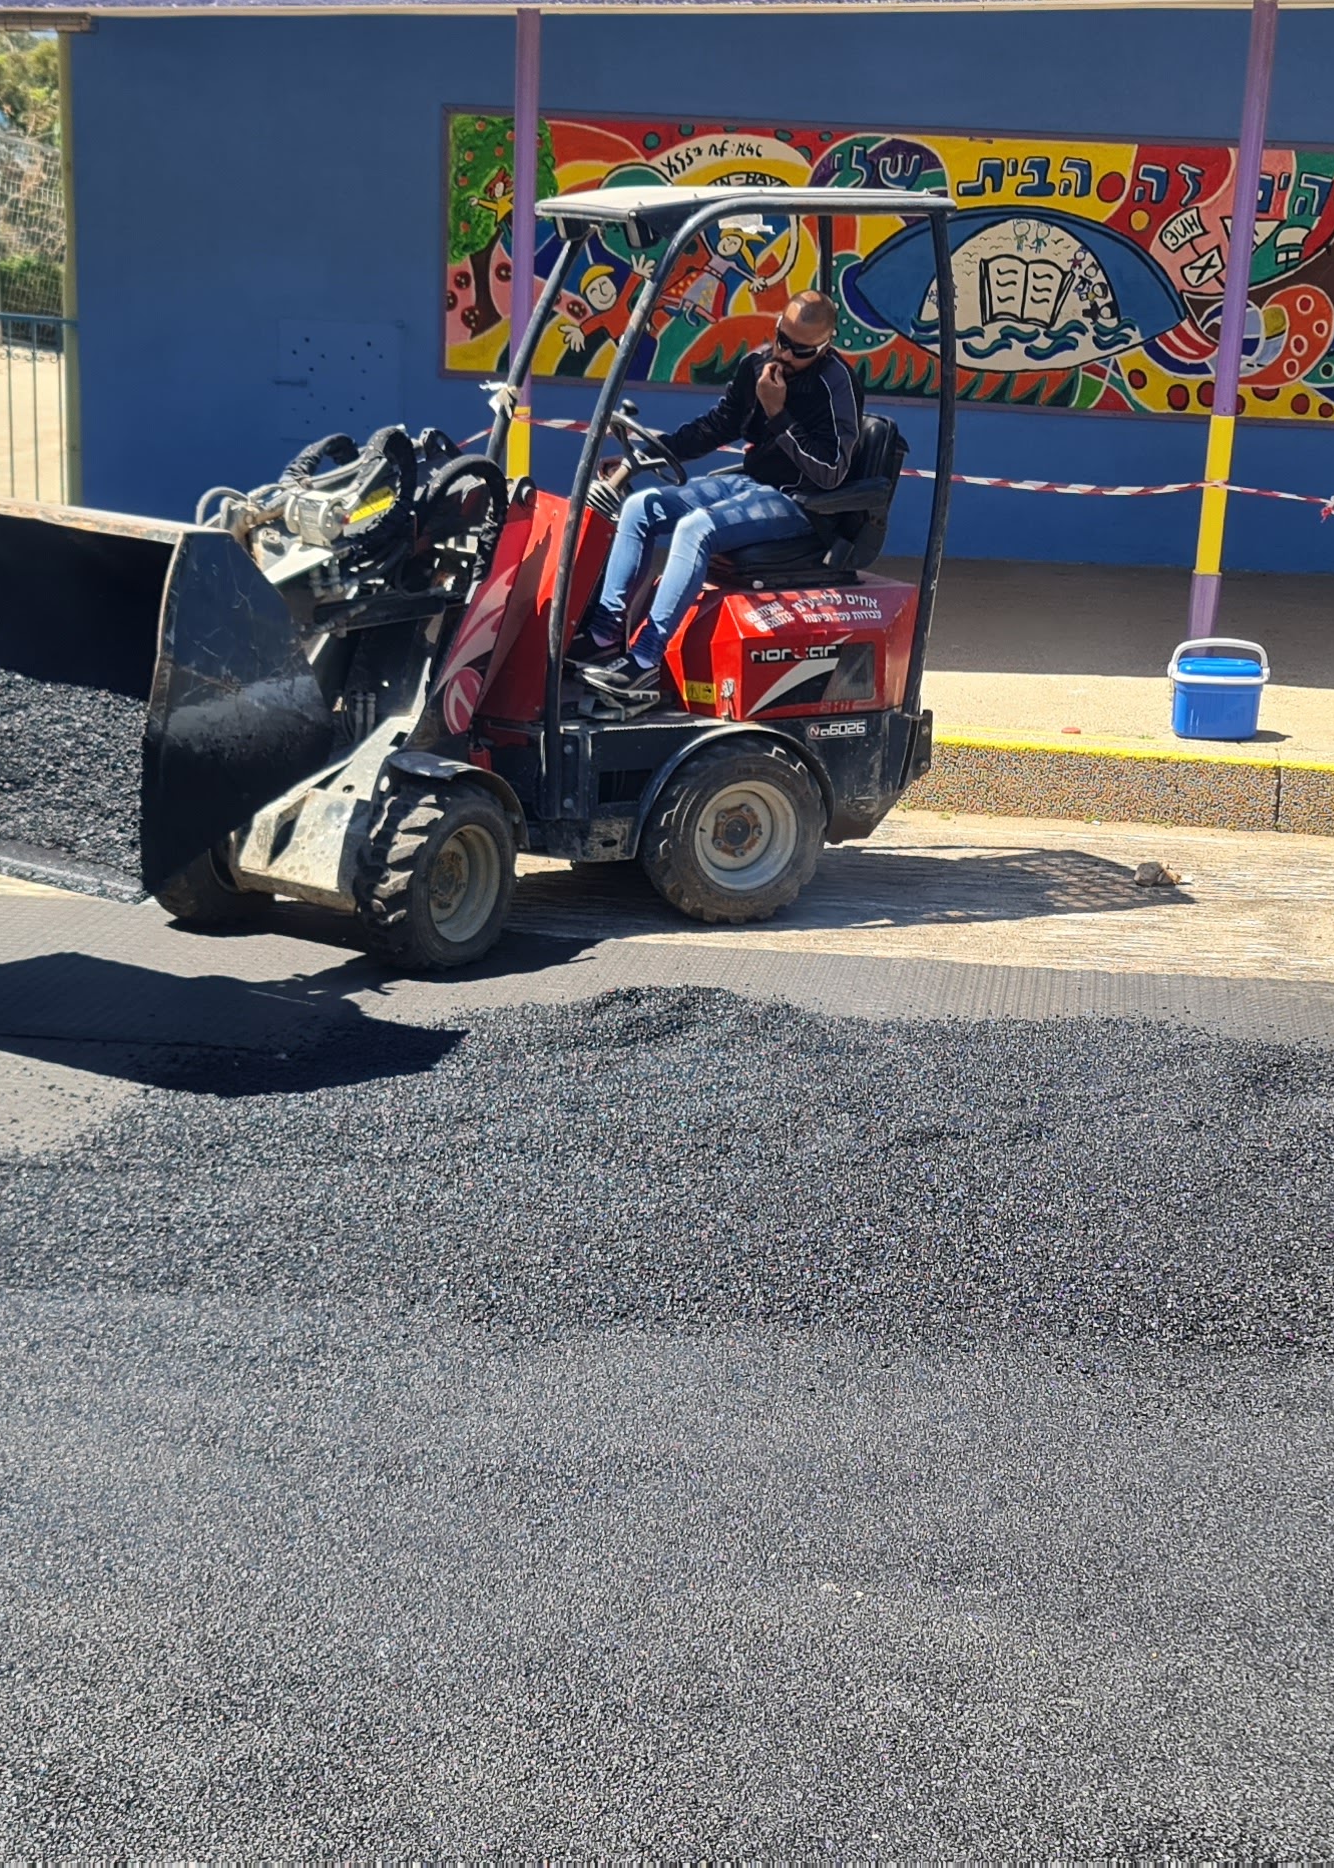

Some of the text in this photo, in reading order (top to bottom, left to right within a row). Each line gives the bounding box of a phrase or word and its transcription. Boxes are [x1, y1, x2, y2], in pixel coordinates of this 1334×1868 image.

[832, 145, 923, 191] שלי
[956, 155, 1093, 198] הבית
[1133, 162, 1206, 207] זה
[844, 593, 878, 609] אחים
